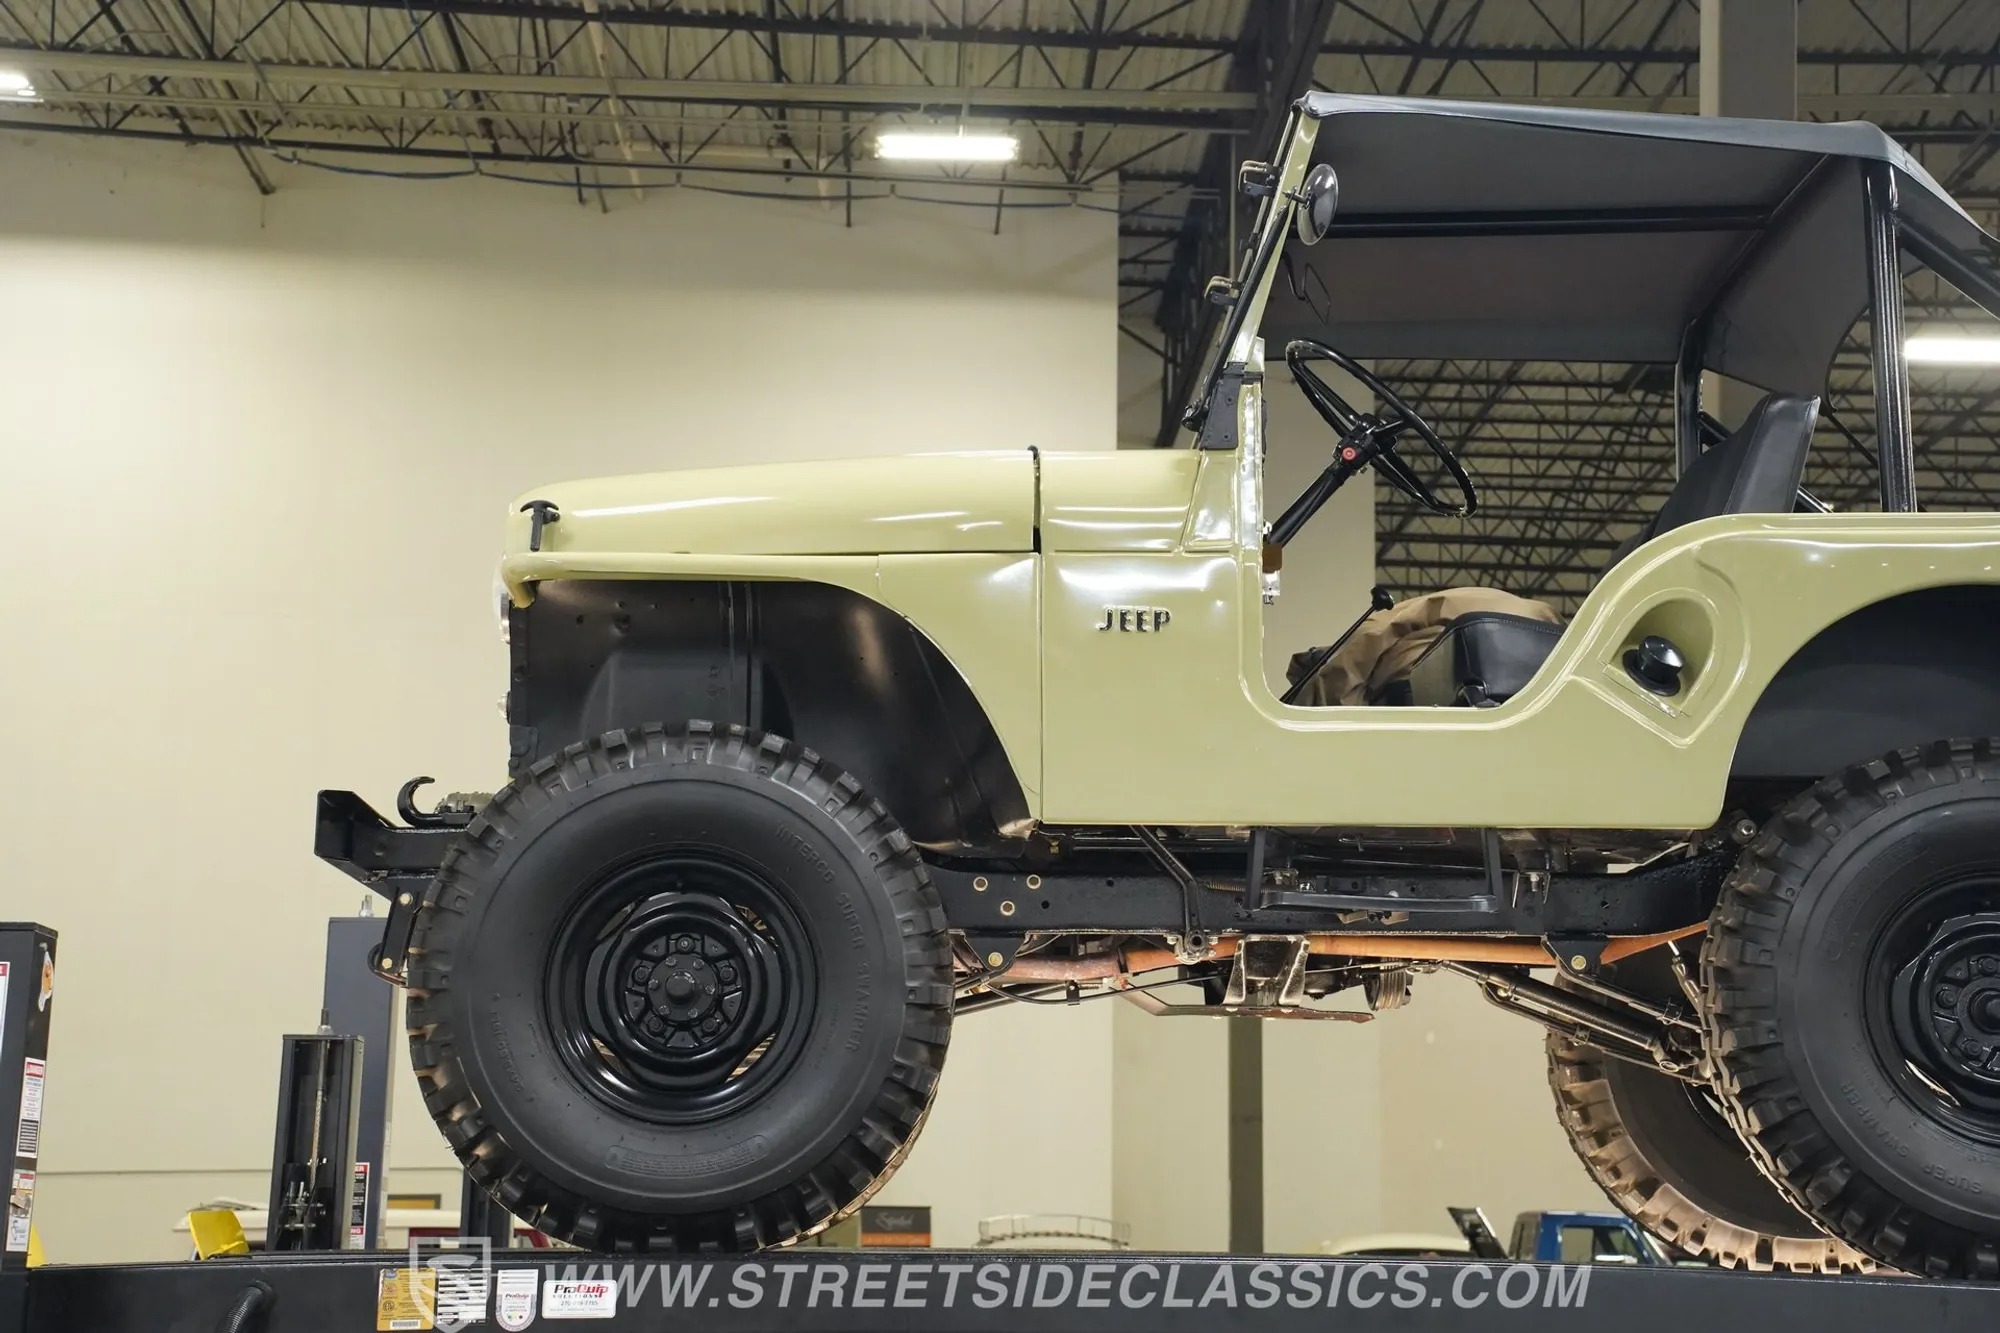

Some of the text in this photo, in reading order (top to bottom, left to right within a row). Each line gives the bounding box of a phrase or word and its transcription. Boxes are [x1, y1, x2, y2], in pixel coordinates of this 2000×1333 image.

[1095, 604, 1172, 633] JEEP
[775, 823, 872, 1053] INTERCO SUPER SWAMPER
[1921, 1163, 1983, 1194] SUPER
[553, 1284, 609, 1298] ProQuip
